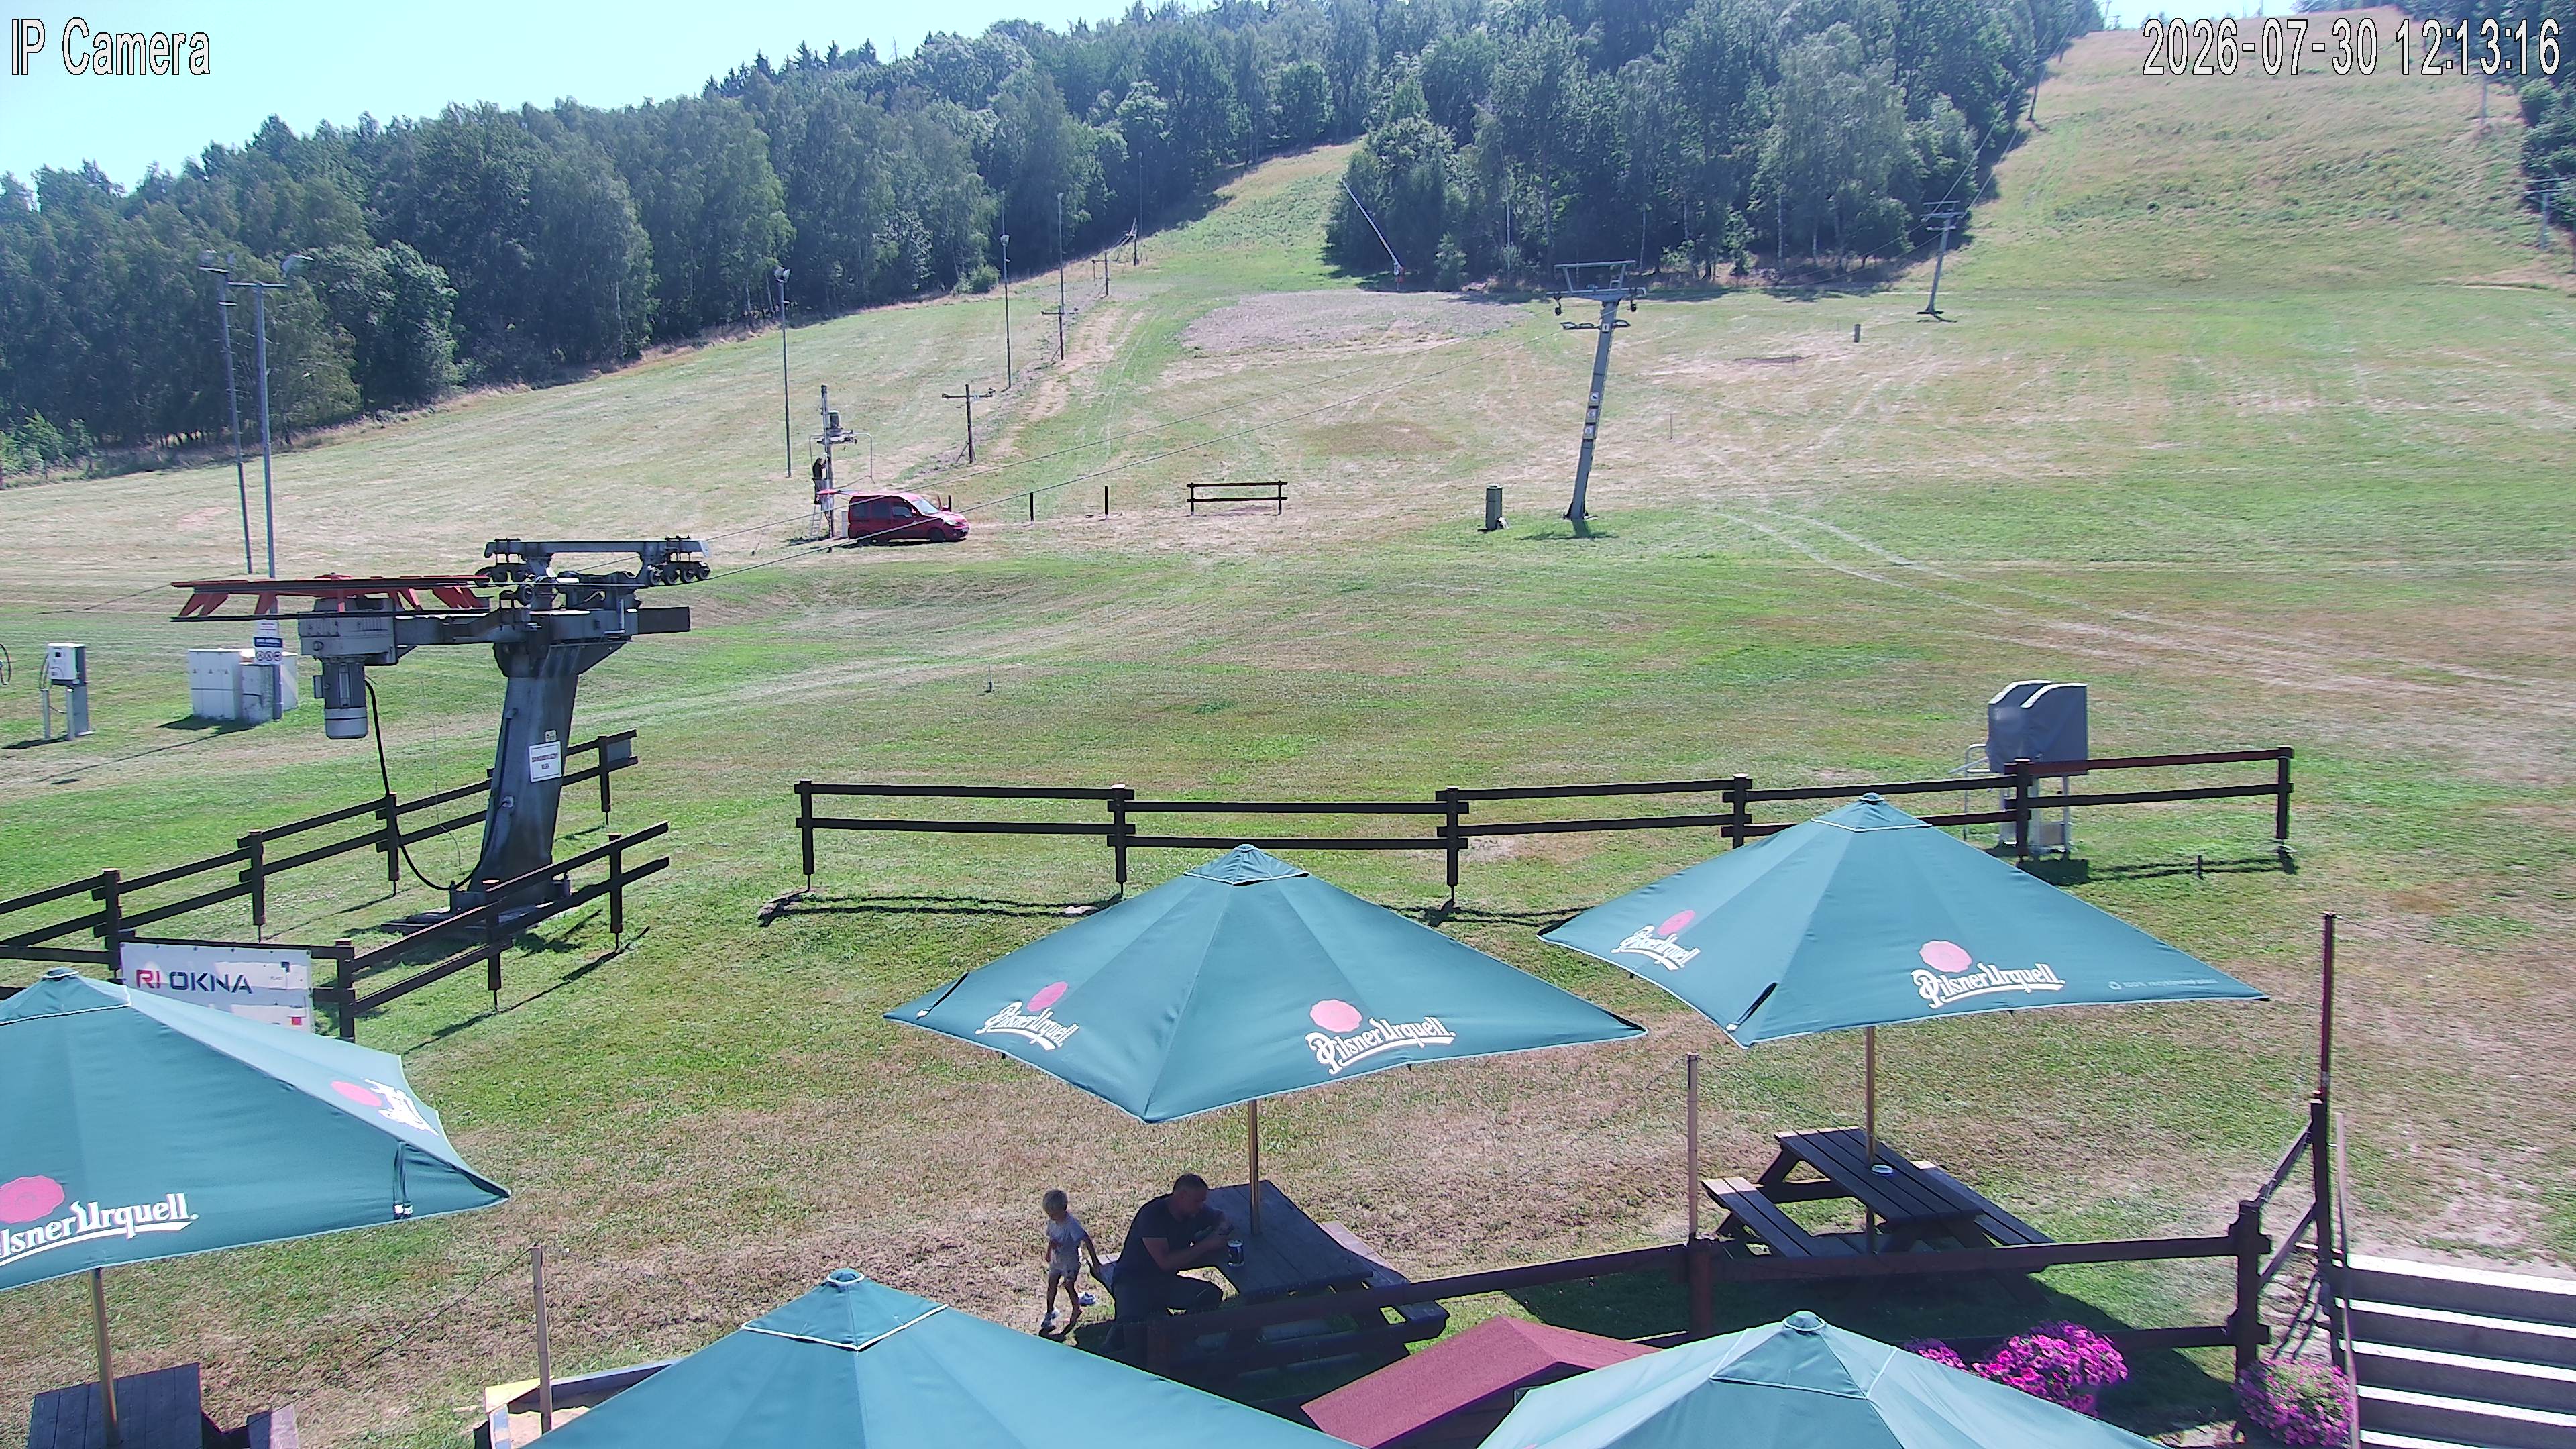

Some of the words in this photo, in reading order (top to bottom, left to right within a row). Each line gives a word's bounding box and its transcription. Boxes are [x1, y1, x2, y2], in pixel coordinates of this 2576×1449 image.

[136, 969, 160, 989] RI
[169, 971, 253, 994] OKNA
[1911, 969, 1990, 1008] Pilsner
[1305, 1032, 1382, 1074] Pilsner
